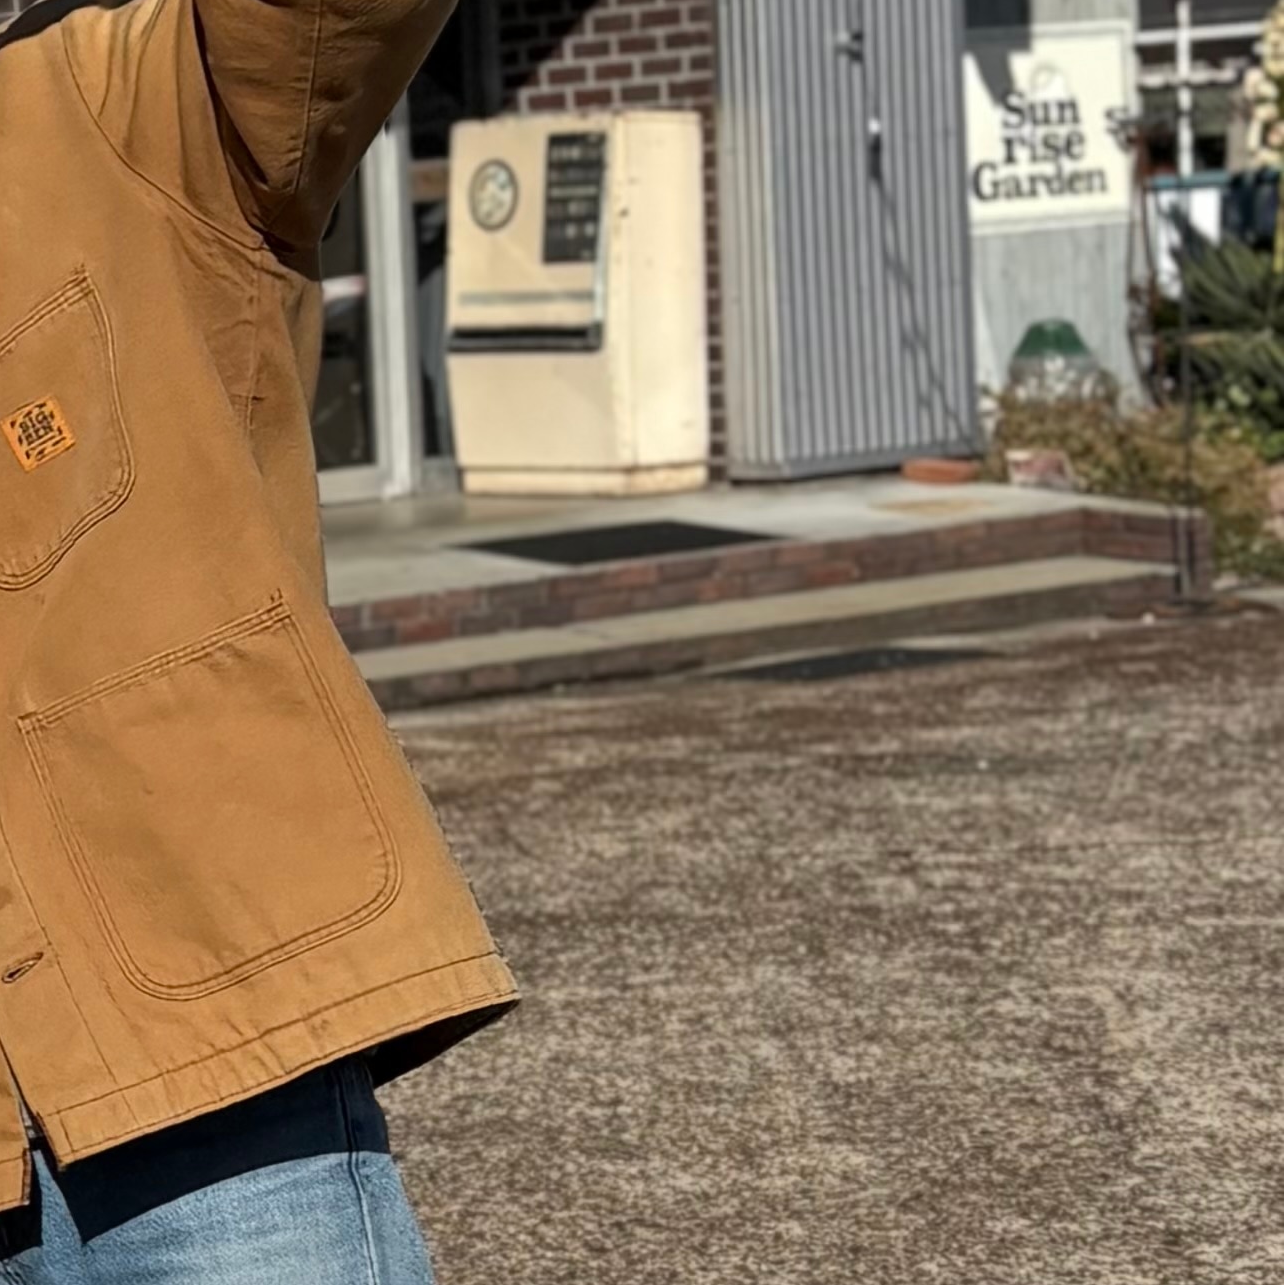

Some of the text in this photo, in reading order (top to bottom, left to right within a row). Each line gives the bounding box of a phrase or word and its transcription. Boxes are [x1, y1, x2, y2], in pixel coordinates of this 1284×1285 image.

[1002, 91, 1081, 129] Sun
[1002, 130, 1086, 165] rise
[972, 161, 1109, 202] Garden
